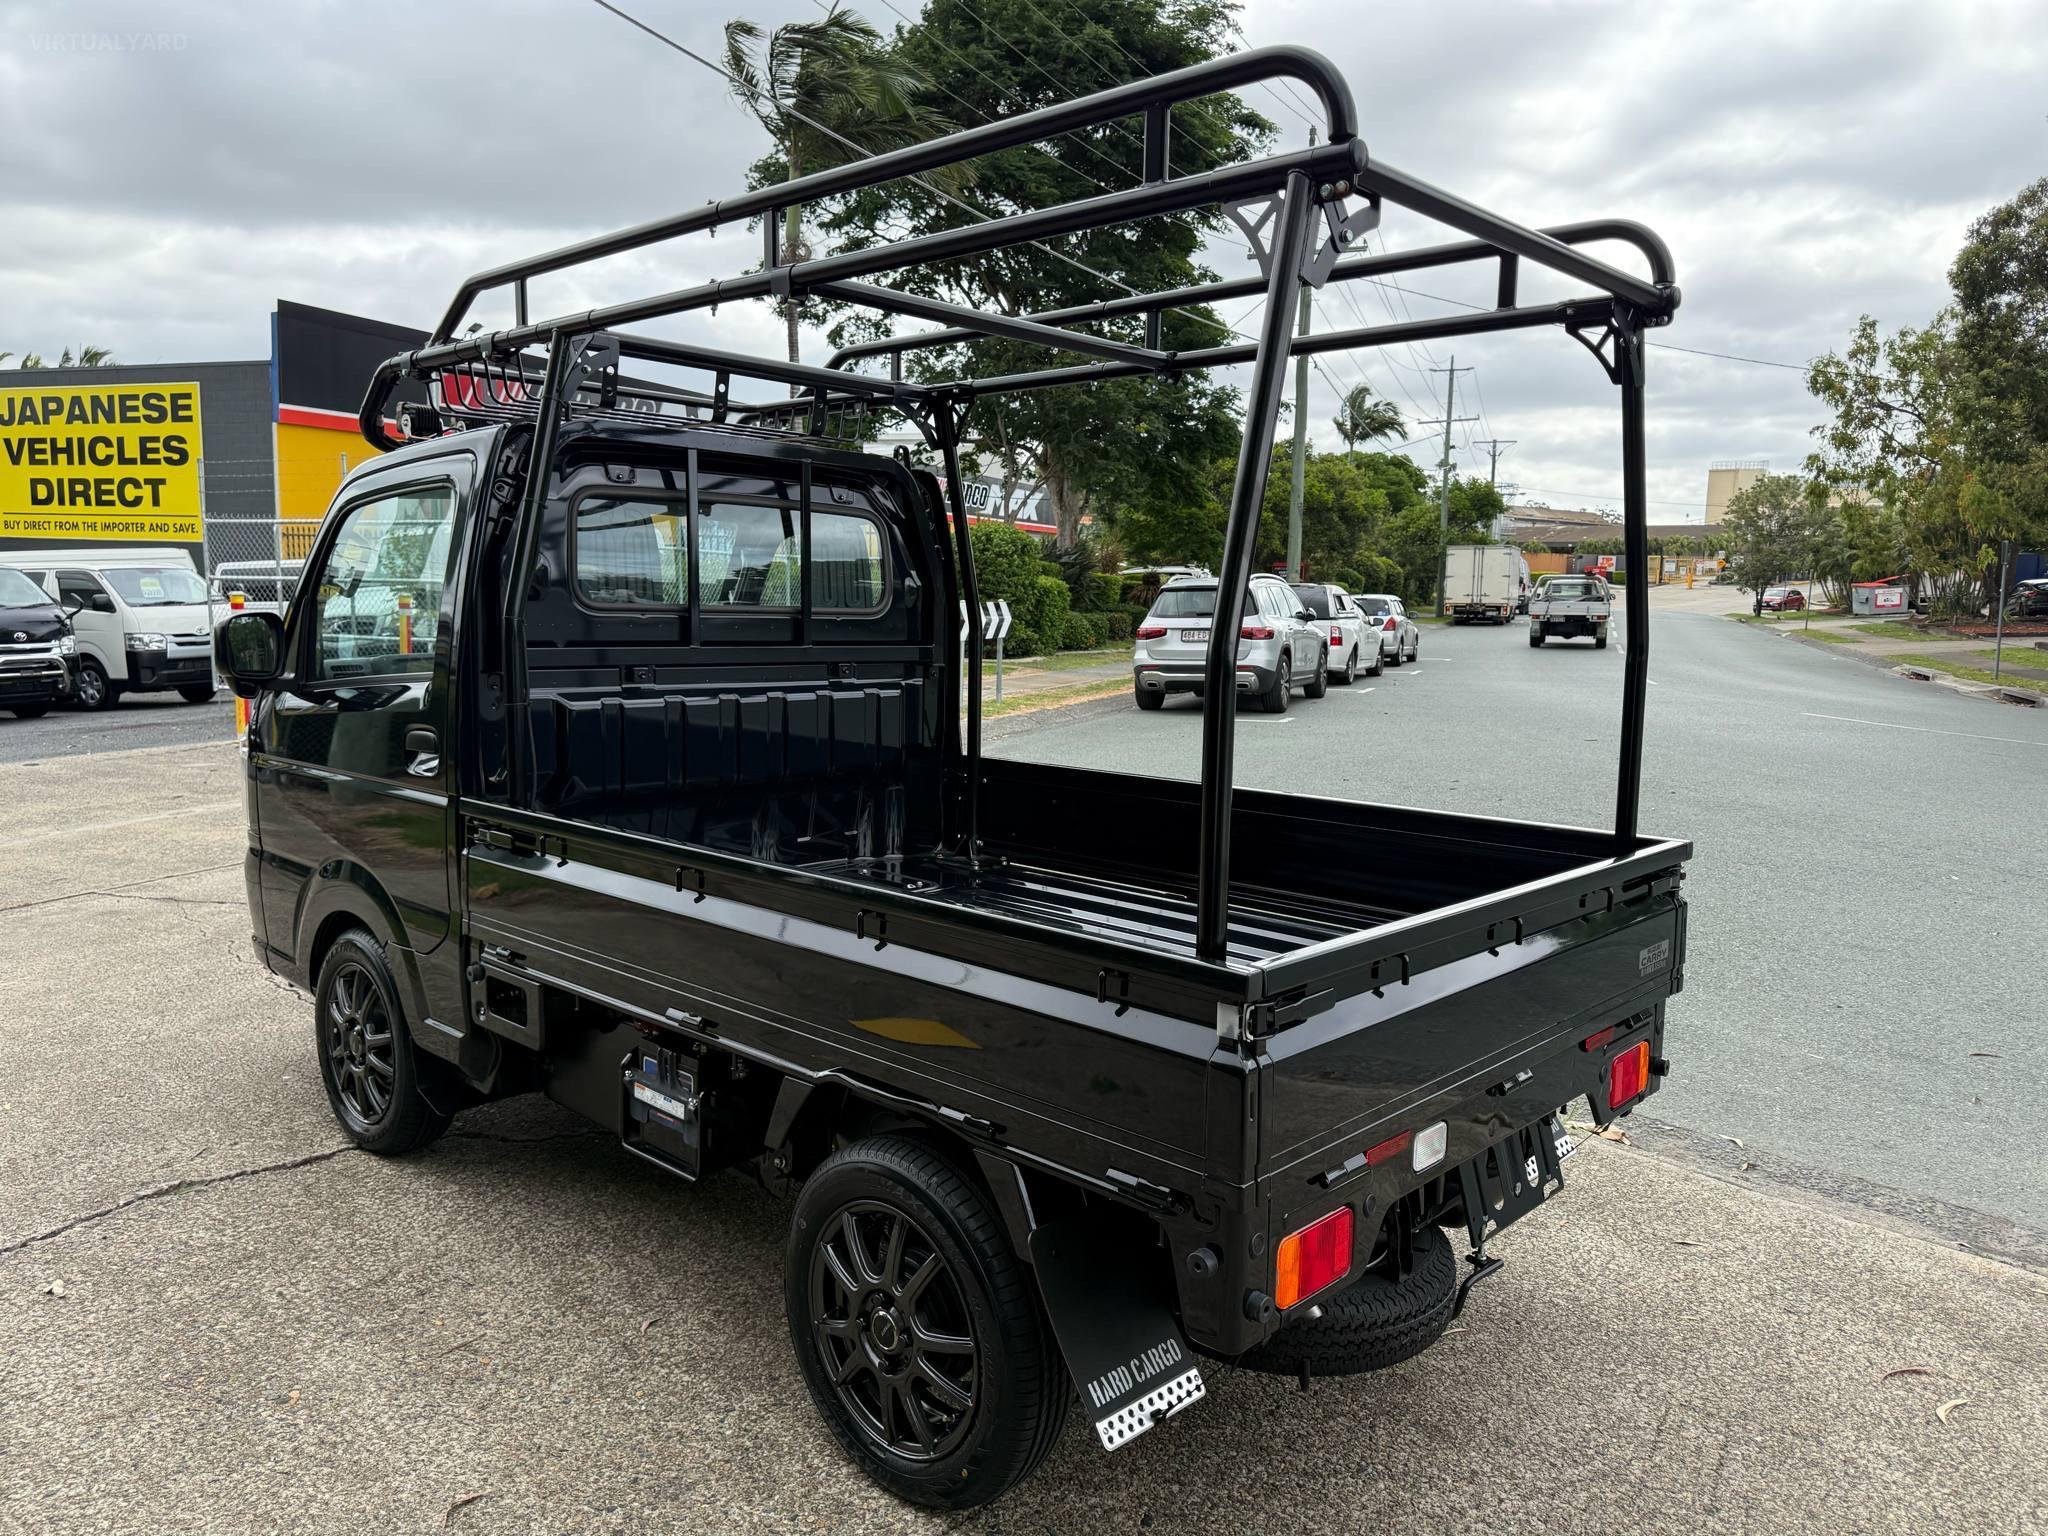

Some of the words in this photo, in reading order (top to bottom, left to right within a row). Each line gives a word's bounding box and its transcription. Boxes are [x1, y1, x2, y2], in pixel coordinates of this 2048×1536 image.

[0, 392, 194, 427] JAPANESE
[3, 435, 190, 467] VEHICLES
[30, 477, 167, 508] DIRECT
[3, 520, 21, 530] BUY
[23, 520, 52, 531] DIRECT
[54, 521, 80, 532] FROM
[81, 521, 98, 532] THE
[100, 522, 146, 533] IMPORTER
[148, 522, 170, 533] AND
[172, 523, 199, 534] SAVE.
[1641, 948, 1667, 967] CARRY
[1087, 1365, 1133, 1408] HARD
[1130, 1338, 1182, 1383] CARGO
